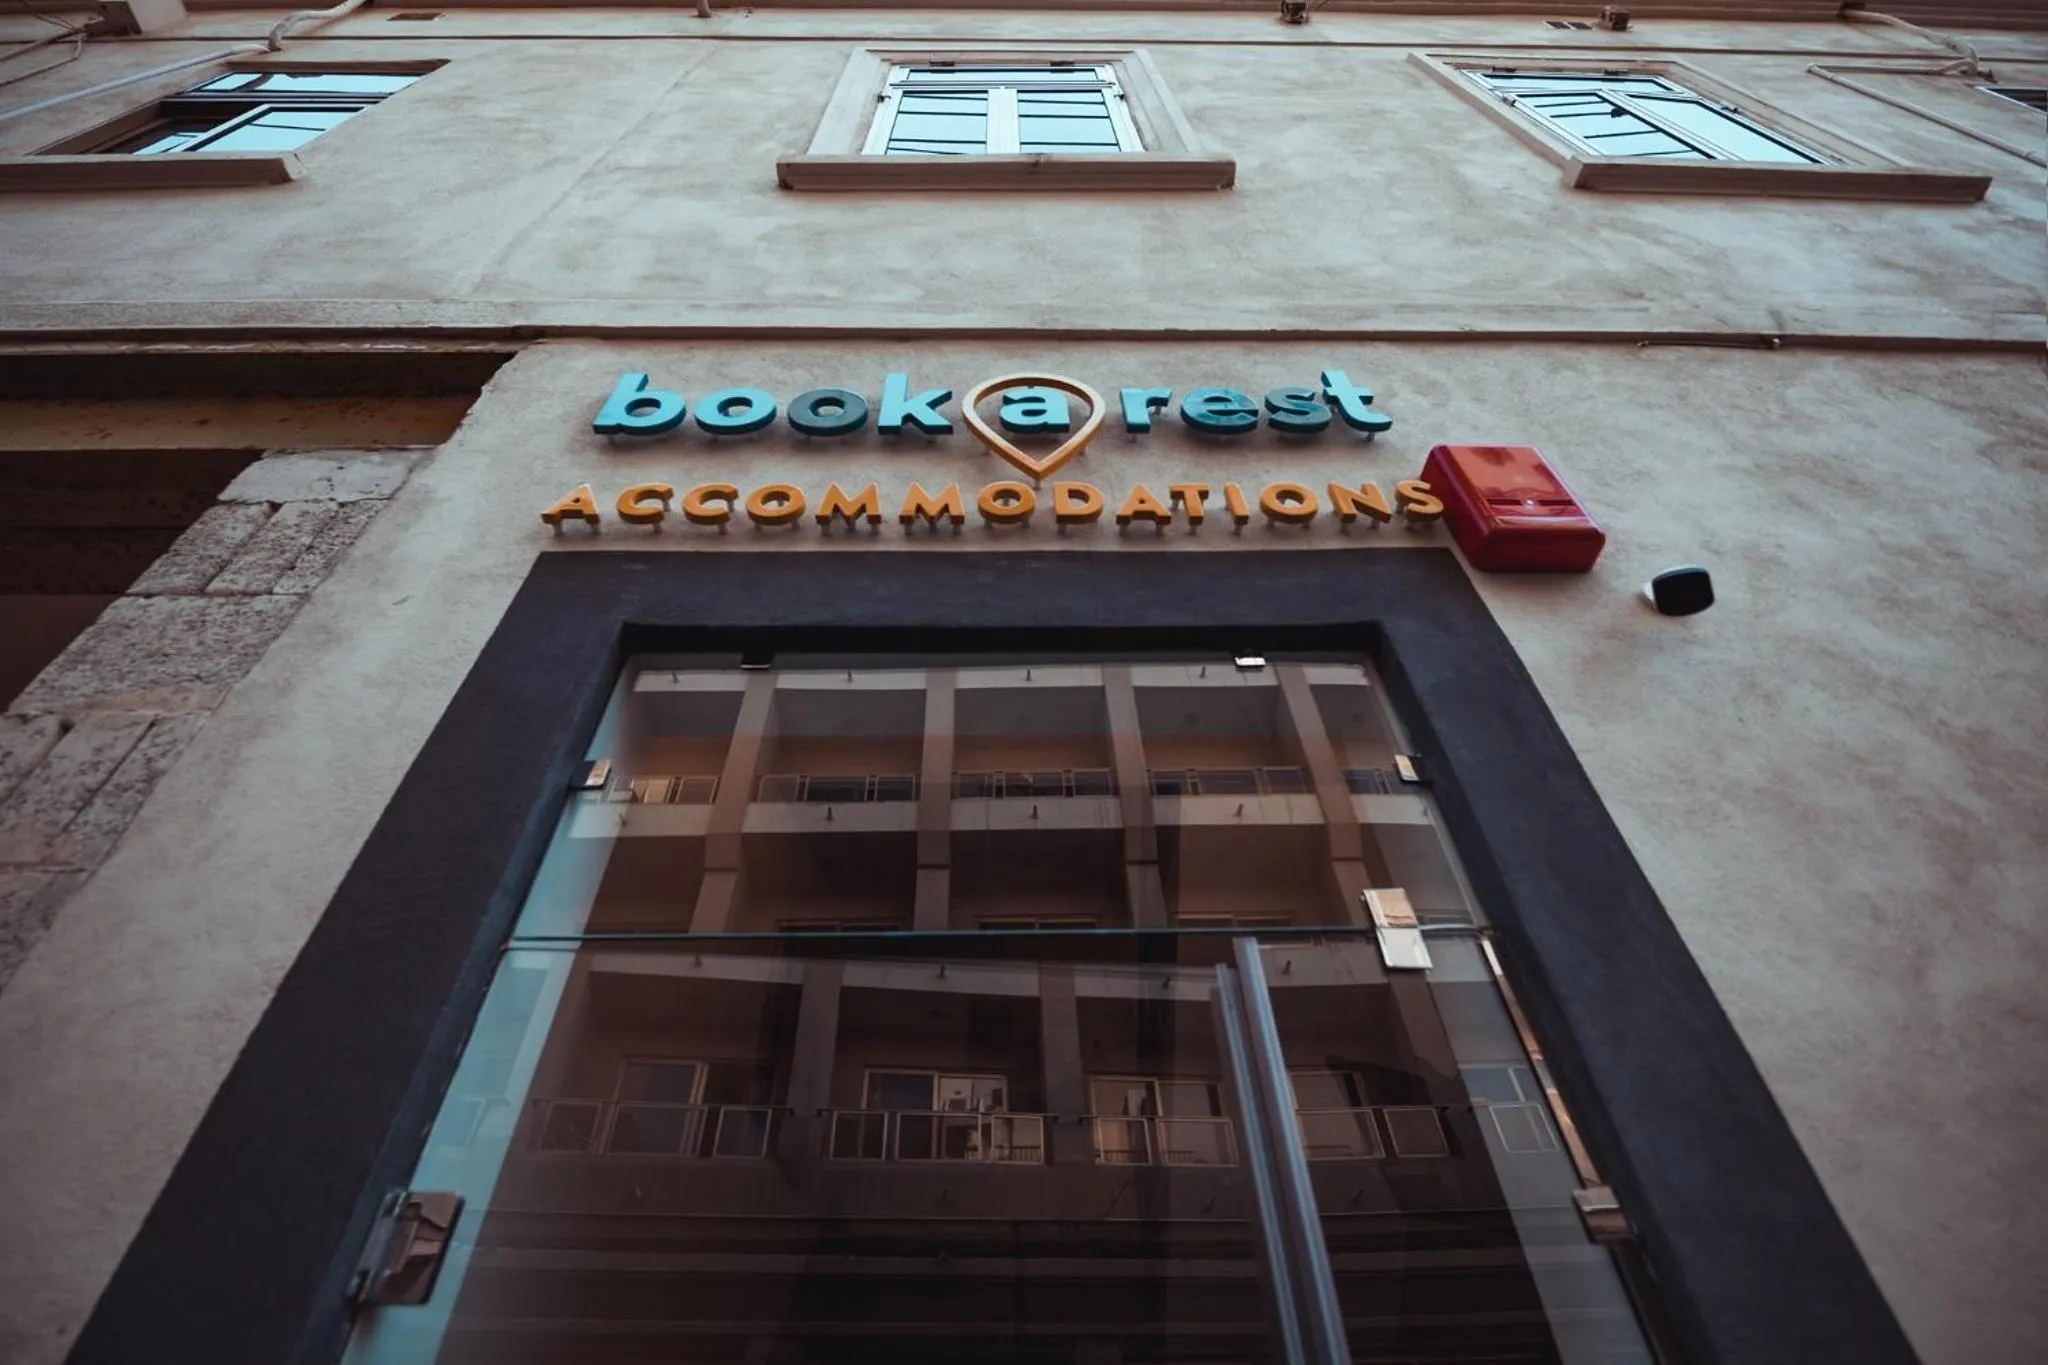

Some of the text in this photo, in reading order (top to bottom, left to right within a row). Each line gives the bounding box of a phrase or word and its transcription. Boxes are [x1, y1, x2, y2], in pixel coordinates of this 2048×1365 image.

[593, 369, 1394, 436] book a rest
[540, 479, 1445, 526] ACCOMMODATIONS
